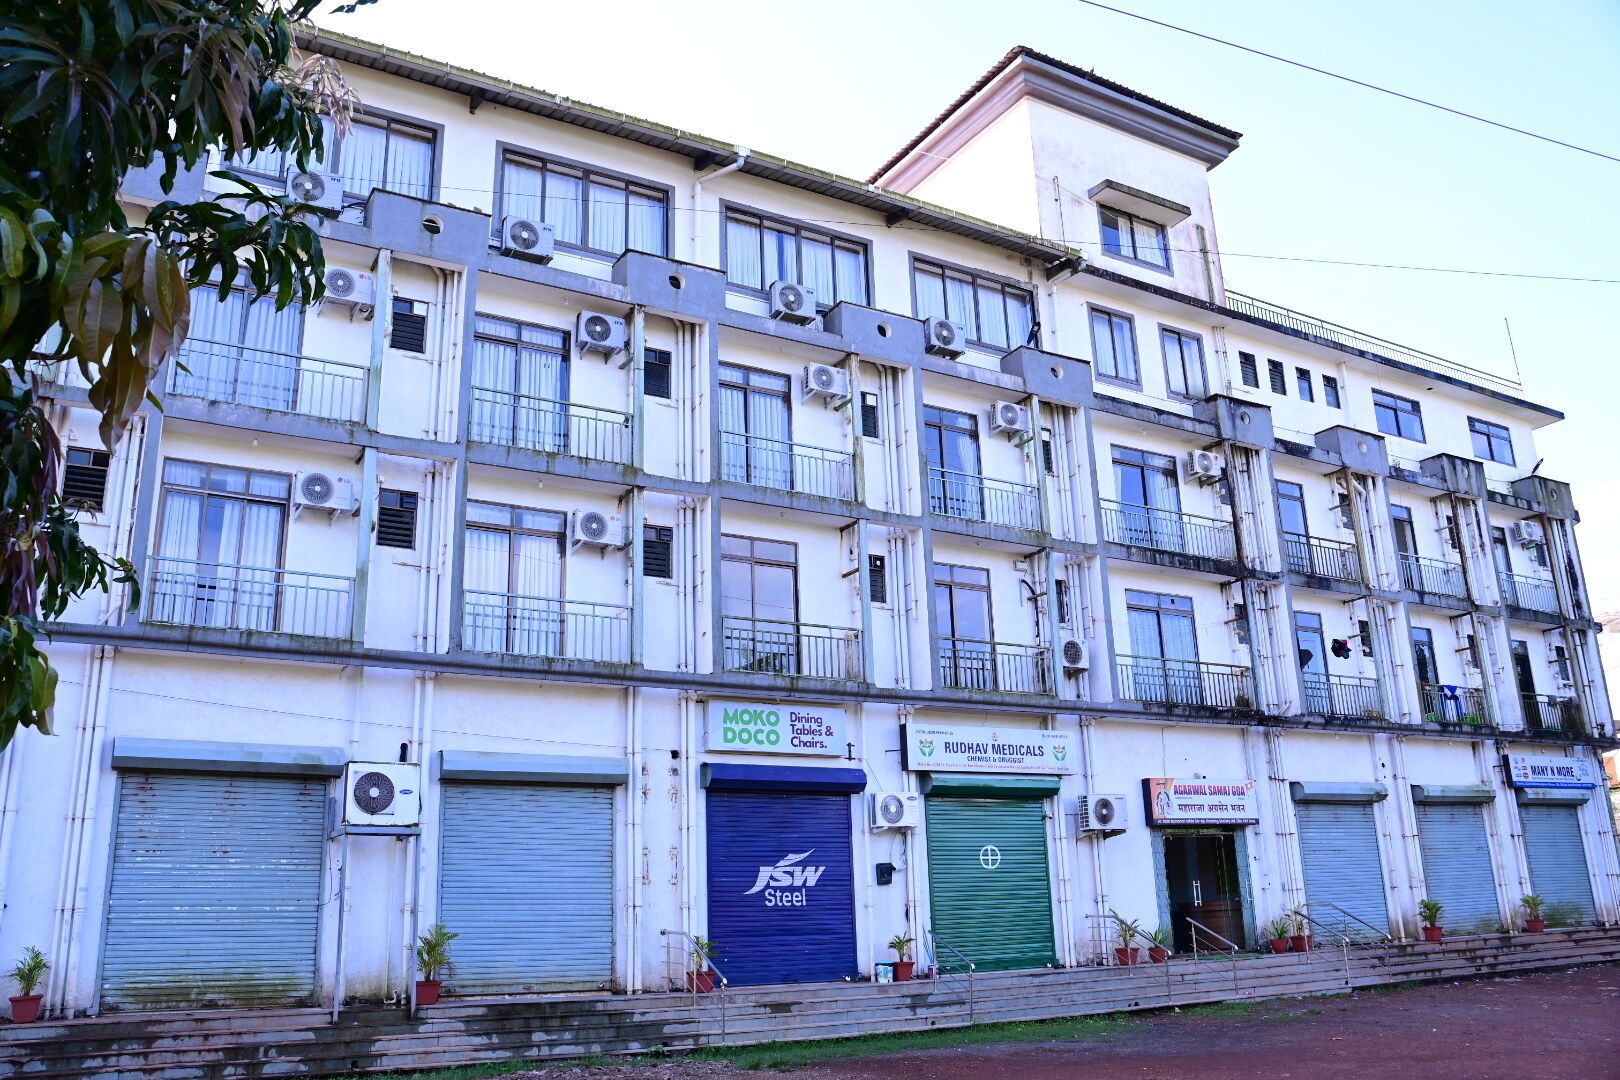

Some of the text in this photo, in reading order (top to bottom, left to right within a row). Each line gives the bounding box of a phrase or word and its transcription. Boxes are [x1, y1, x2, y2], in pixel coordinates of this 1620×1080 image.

[722, 707, 780, 727] MOKO
[789, 711, 823, 727] Dining
[722, 726, 780, 746] DOCO
[789, 724, 834, 737] Tables &
[790, 736, 828, 749] Chairs.
[944, 741, 1045, 757] RUDHAV MEDICALS
[967, 755, 992, 763] CHEMIST
[1530, 765, 1549, 777] MANY
[1549, 766, 1556, 777] N
[1556, 766, 1575, 778] MORE
[1173, 784, 1246, 797] AGARWAL SAMAJ GOA
[1177, 800, 1246, 813] महाराजा अग्रसेन भवन
[743, 866, 826, 895] JSW
[764, 888, 807, 907] Steel
